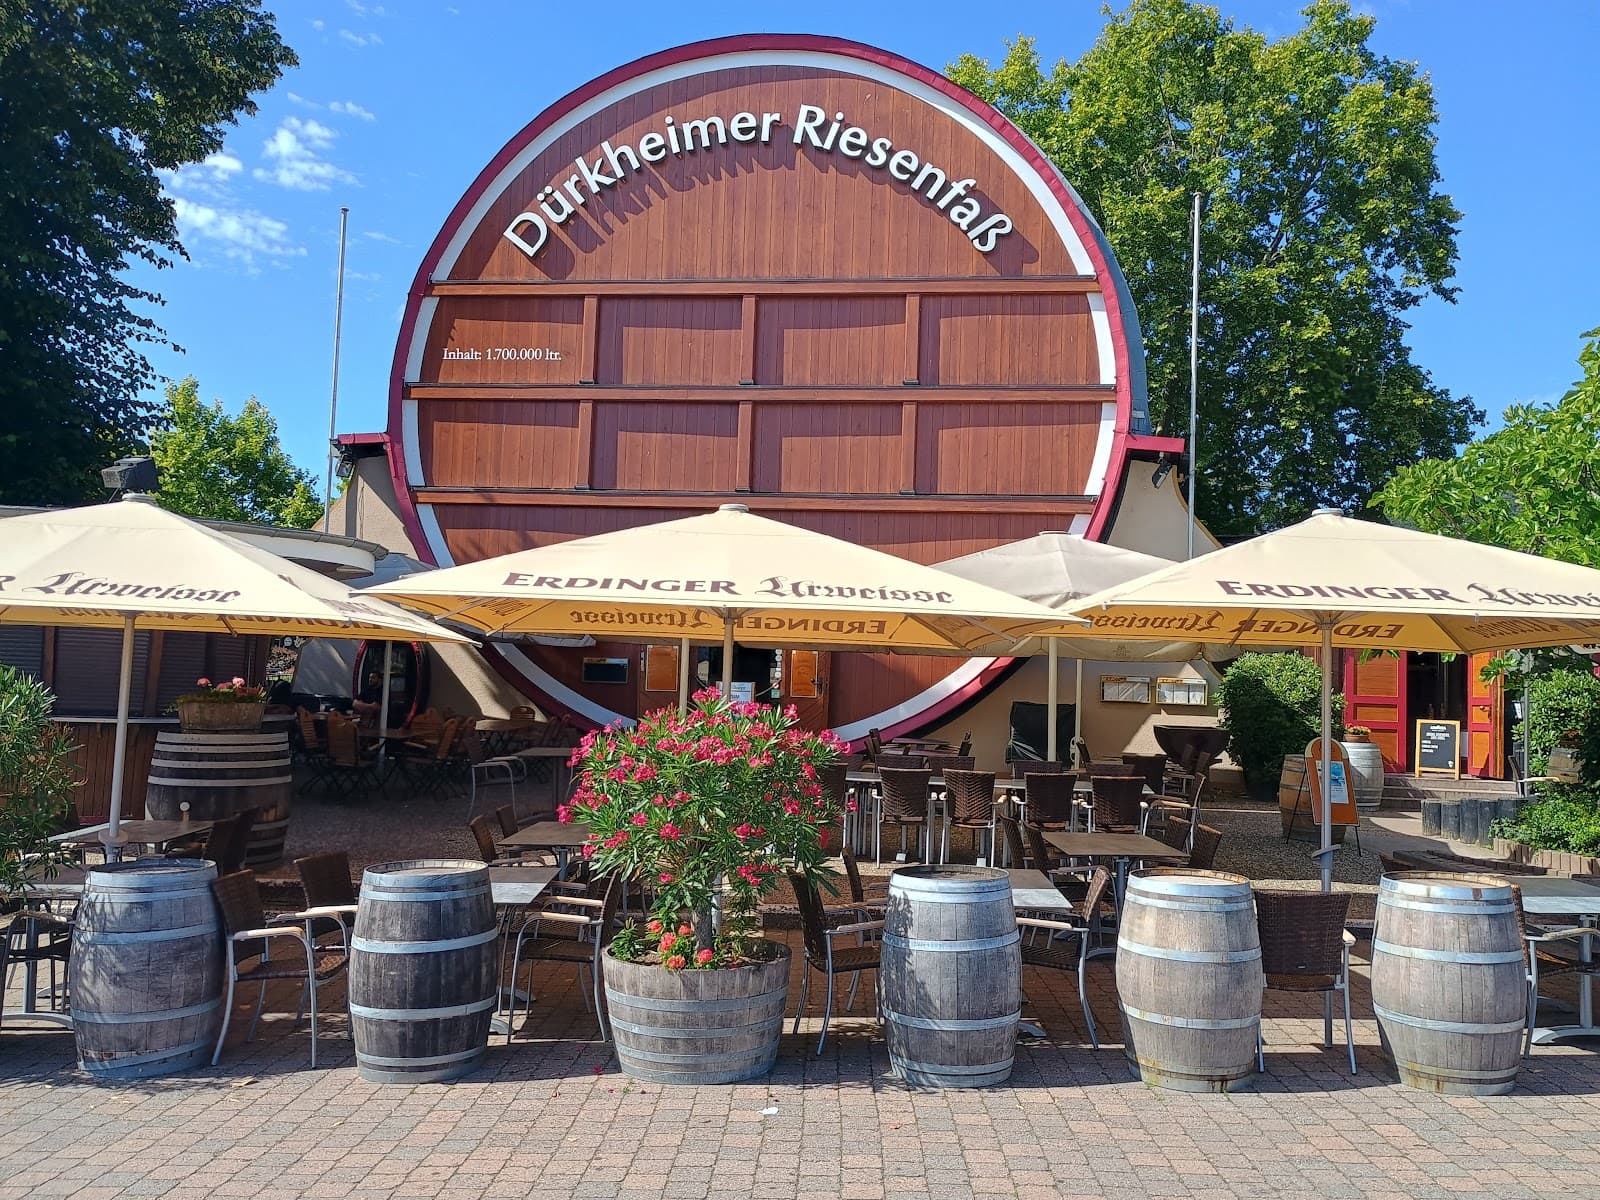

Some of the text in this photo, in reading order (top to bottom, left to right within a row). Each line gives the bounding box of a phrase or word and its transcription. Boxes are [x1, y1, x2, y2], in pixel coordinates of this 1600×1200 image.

[502, 103, 1013, 259] Dürkheimer Riesenfaß
[442, 347, 562, 361] Inhalt: 1.700.000 ltr.
[22, 571, 241, 603] Urweisse
[502, 572, 955, 604] ERDINGER Urweisse
[1216, 580, 1470, 604] ERDINGER
